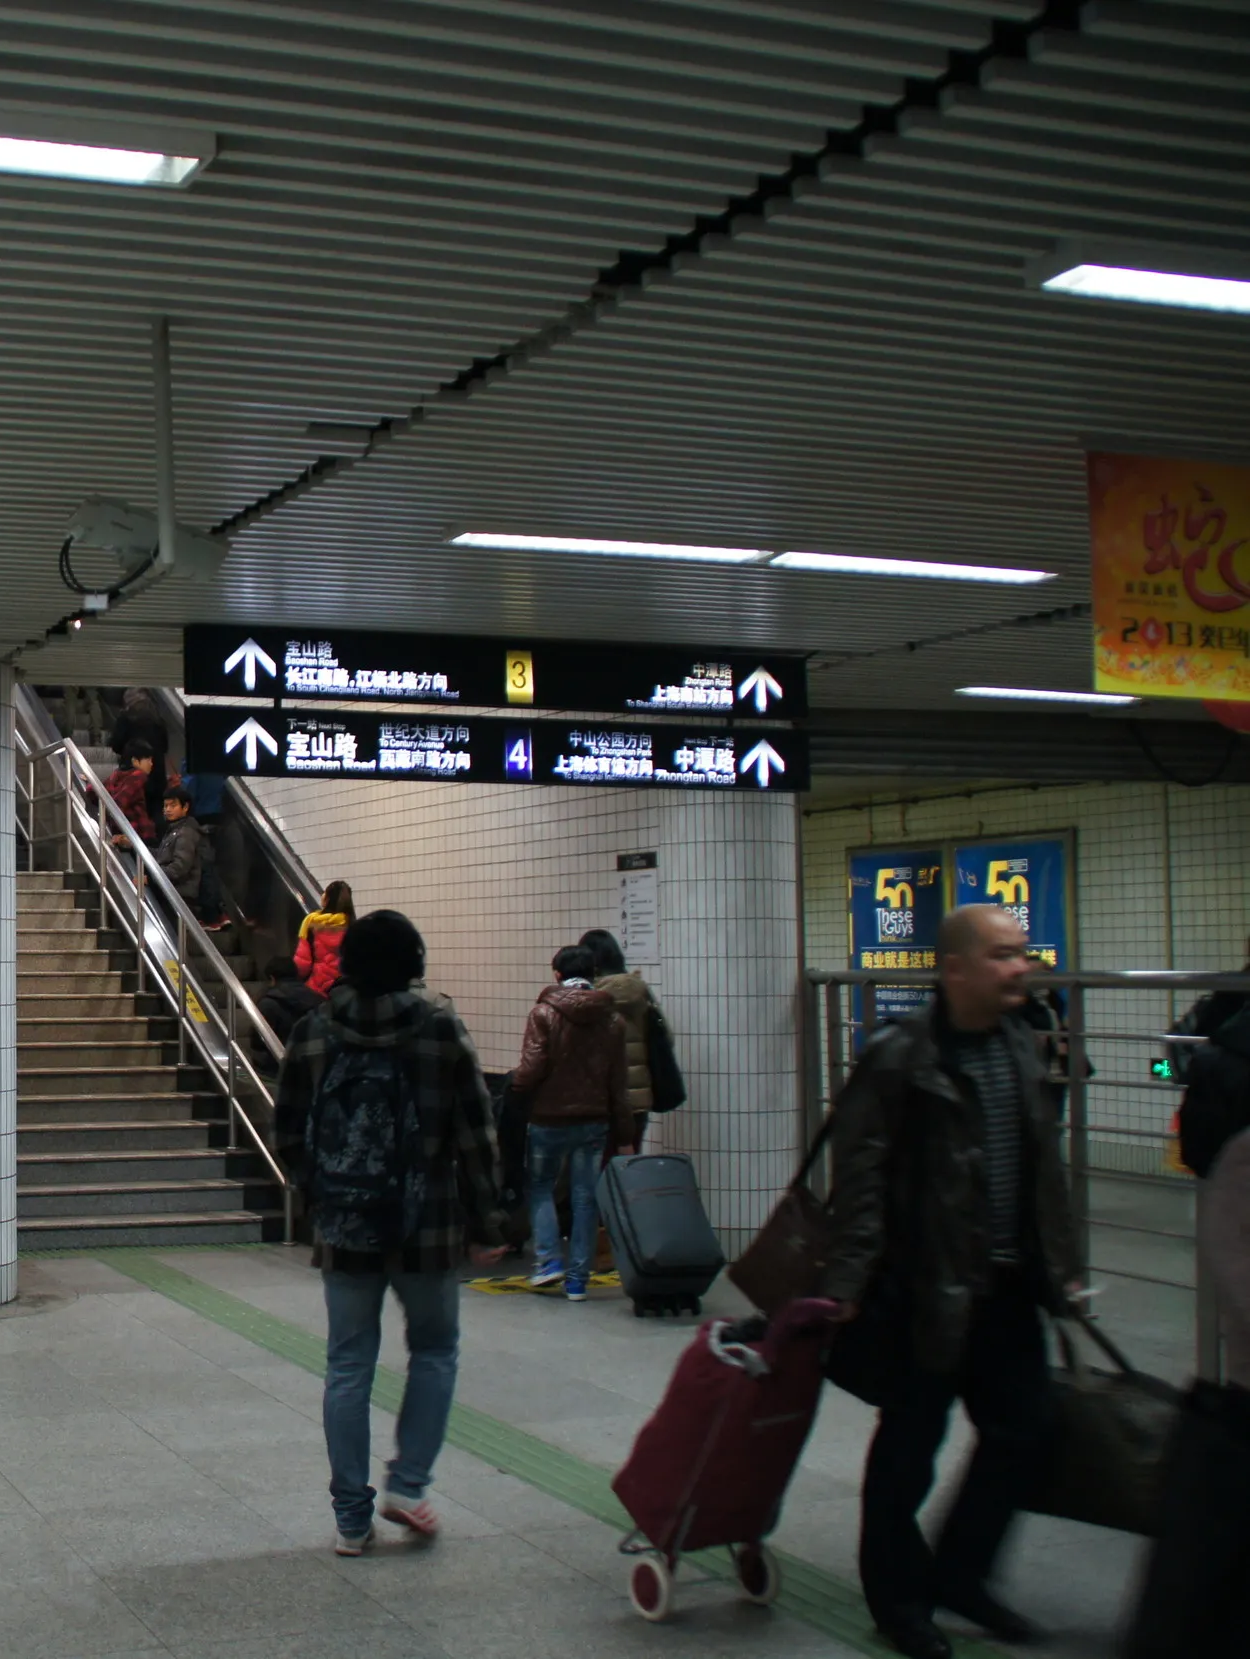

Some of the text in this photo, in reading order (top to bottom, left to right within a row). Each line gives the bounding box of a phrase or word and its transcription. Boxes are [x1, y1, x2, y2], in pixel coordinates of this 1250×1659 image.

[286, 640, 333, 658] 宝山路
[285, 657, 338, 667] Baoshan Road
[693, 662, 732, 679] 中潭路
[512, 661, 526, 688] 3
[715, 678, 733, 687] Road
[287, 718, 317, 731] 下一站
[380, 723, 470, 742] 世纪大道方向
[286, 731, 358, 760] 宝山路
[379, 738, 445, 750] To Century Avenue
[569, 730, 653, 748] 中山公园方向
[379, 748, 471, 770] 西藏南路方向
[509, 739, 528, 771] 4
[590, 747, 599, 755] To
[637, 748, 653, 756] Park
[674, 746, 736, 773] 中潭路
[285, 756, 341, 771] Baoshan
[342, 758, 377, 772] Road
[655, 769, 705, 785] Zhongtan
[708, 771, 736, 784] Road
[861, 951, 936, 969] 商业就是这样
